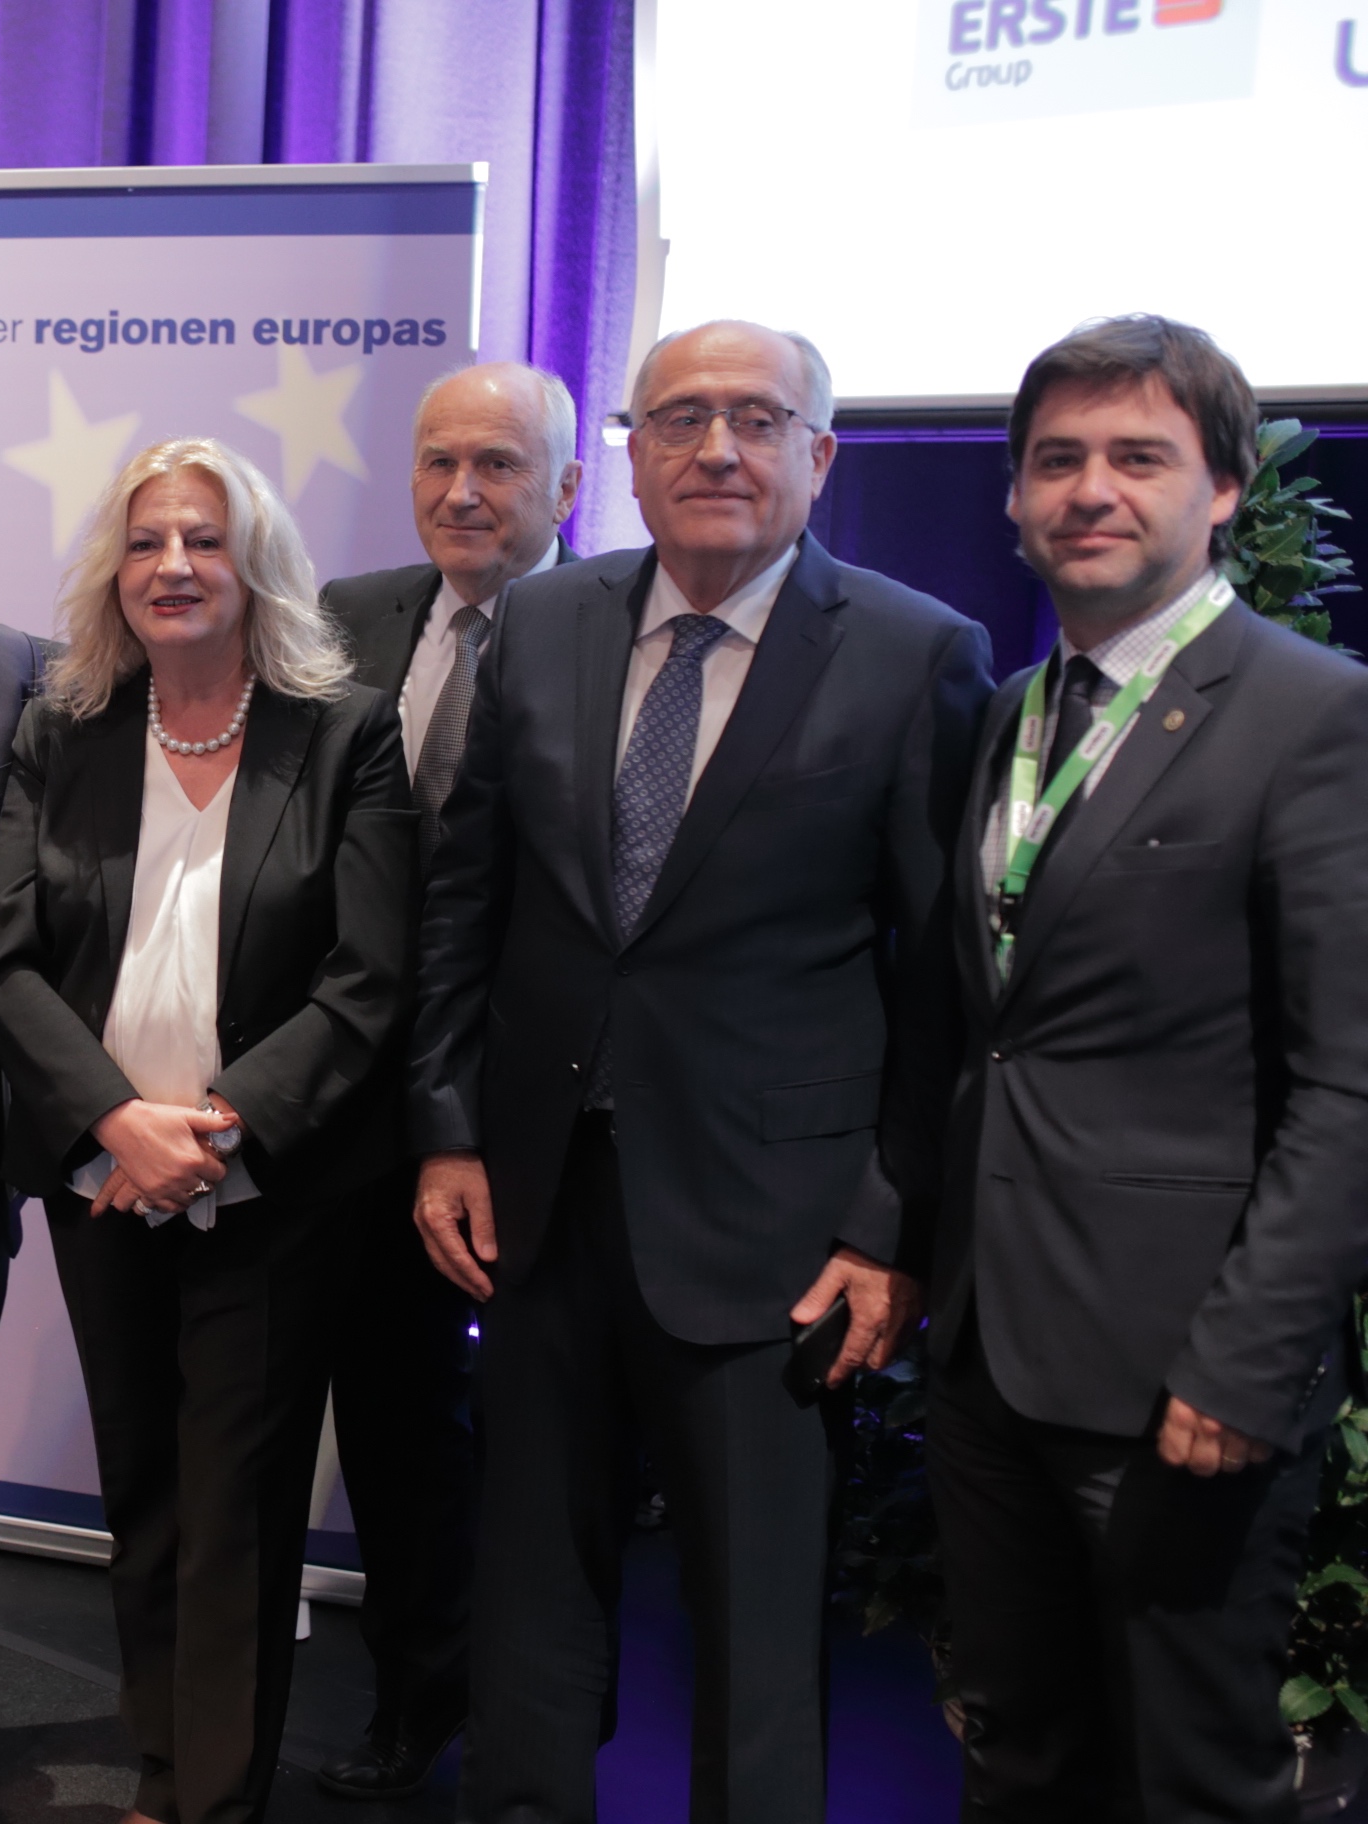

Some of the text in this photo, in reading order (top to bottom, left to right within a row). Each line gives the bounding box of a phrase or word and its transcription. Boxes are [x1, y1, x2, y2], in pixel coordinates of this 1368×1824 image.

[944, 59, 1033, 92] Group
[33, 309, 236, 354] regionen
[251, 316, 448, 356] europas
